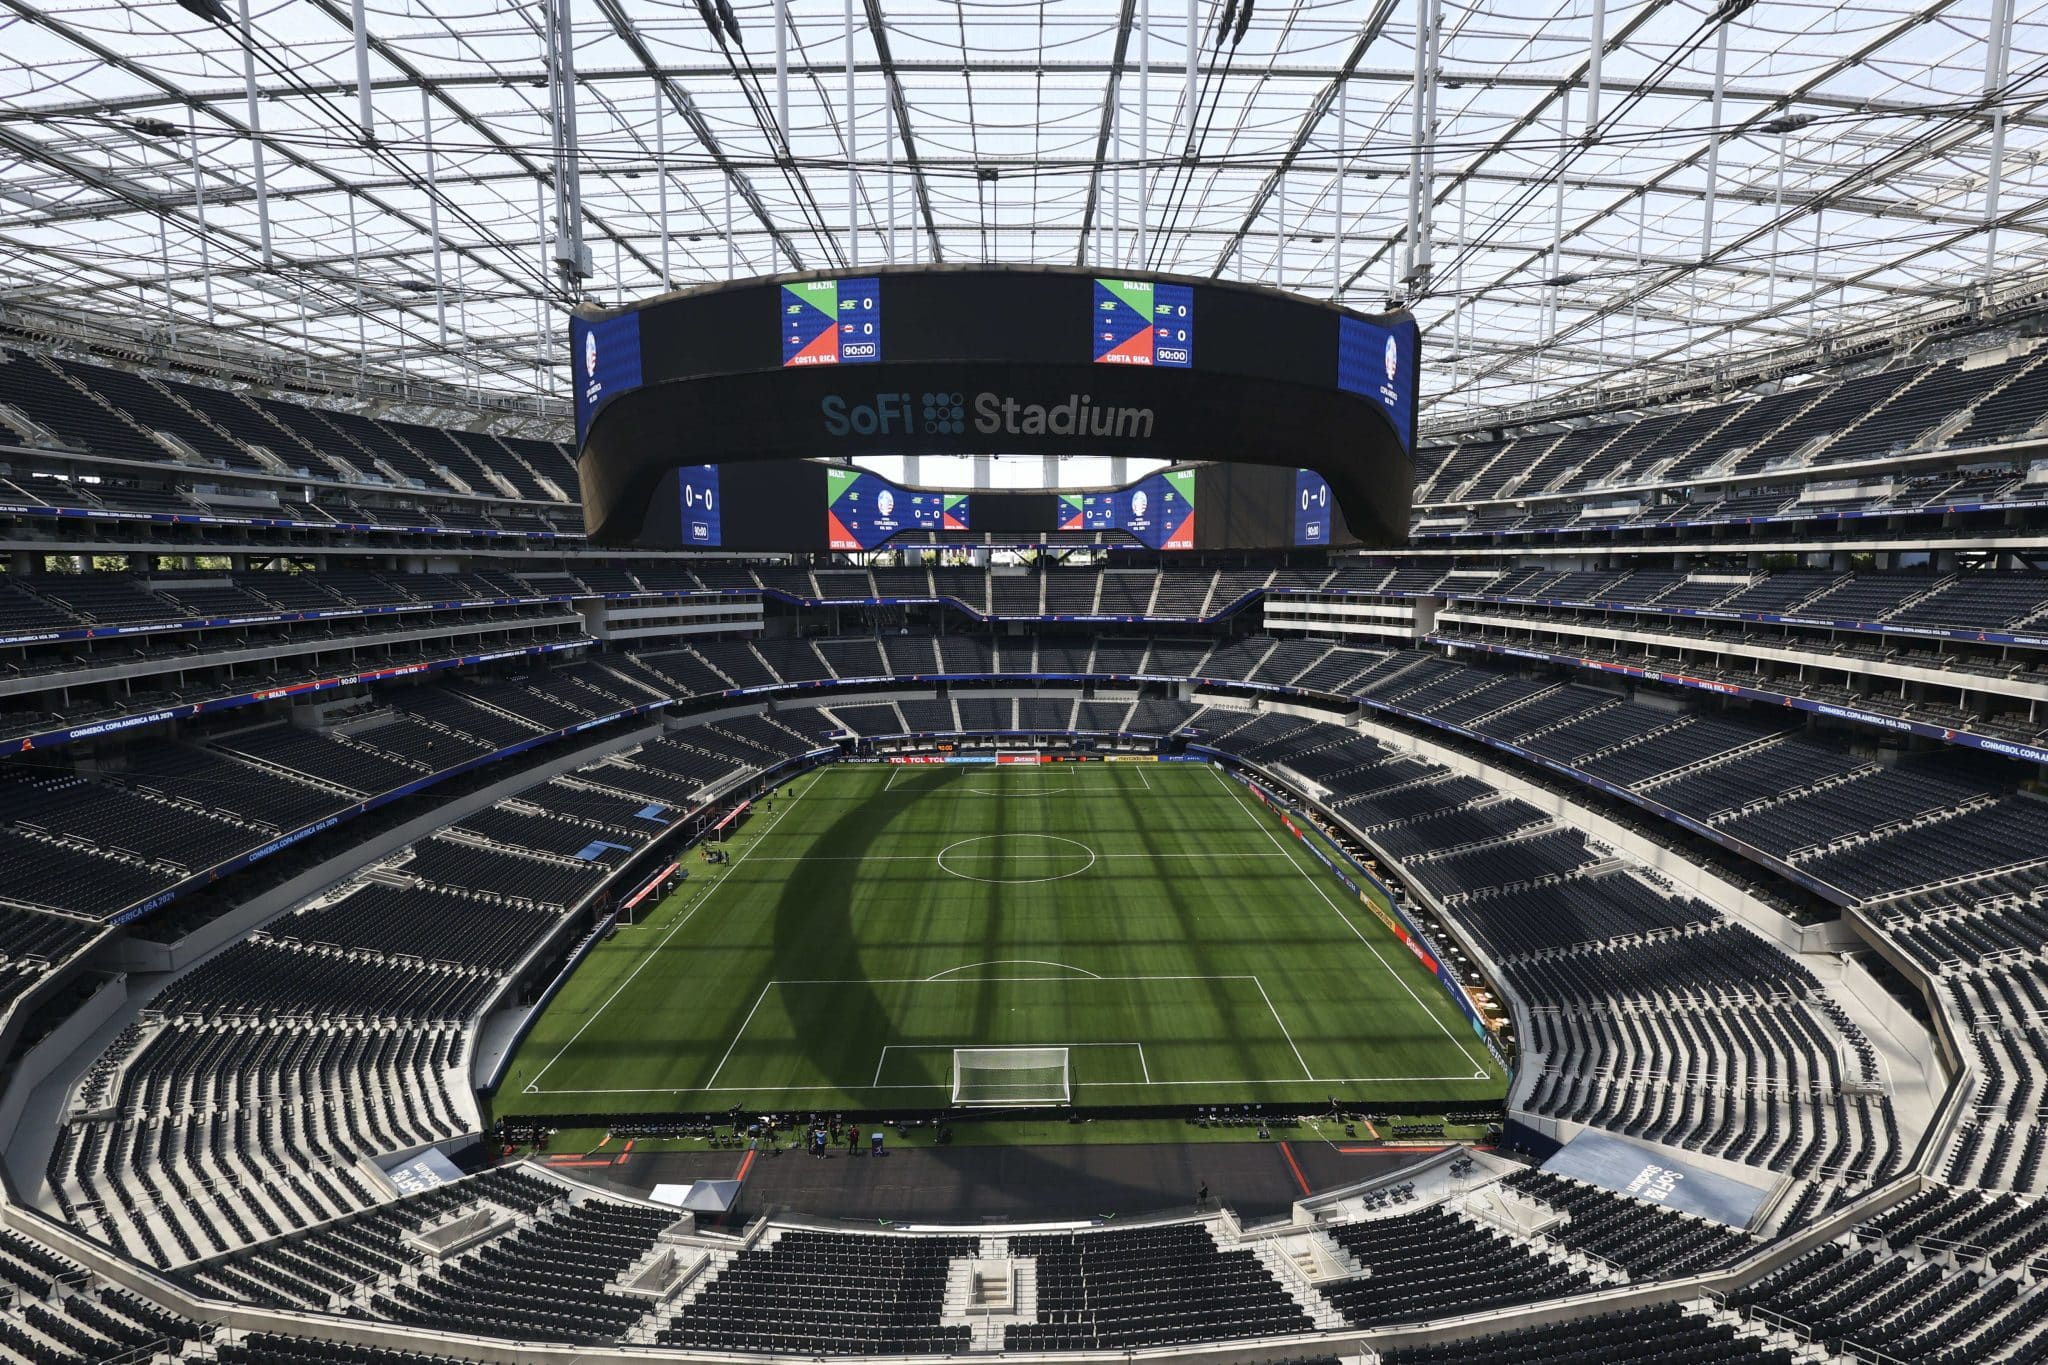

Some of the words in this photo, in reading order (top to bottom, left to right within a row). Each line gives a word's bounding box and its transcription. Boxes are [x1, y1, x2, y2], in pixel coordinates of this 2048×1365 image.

[864, 298, 872, 310] 0
[1178, 306, 1187, 317] 0
[864, 323, 873, 335] 0
[1177, 330, 1186, 341] 0
[845, 346, 873, 355] 90:00
[1159, 350, 1185, 360] 90:00
[795, 355, 817, 364] COSTA
[819, 354, 836, 363] RICA
[1107, 354, 1130, 363] COSTA
[1132, 355, 1150, 364] RICA
[821, 393, 914, 437] SoFi
[974, 392, 1154, 437] Stadium
[341, 677, 358, 685] 90:00
[1818, 705, 1848, 717] CONMEBOL
[1847, 711, 1861, 720] COPA
[1861, 713, 1885, 725] AMERICA
[70, 726, 105, 738] CONMEBOL
[105, 721, 122, 731] COPA
[121, 717, 148, 728] AMERICA
[1981, 740, 2020, 755] CONMEBOL
[2020, 748, 2040, 760] COPA
[293, 826, 316, 841] AMERICA
[144, 900, 158, 912] USA
[1406, 936, 1424, 960] Betano
[1625, 1164, 1663, 1193] Stadium
[1651, 1170, 1685, 1193] SoFi
